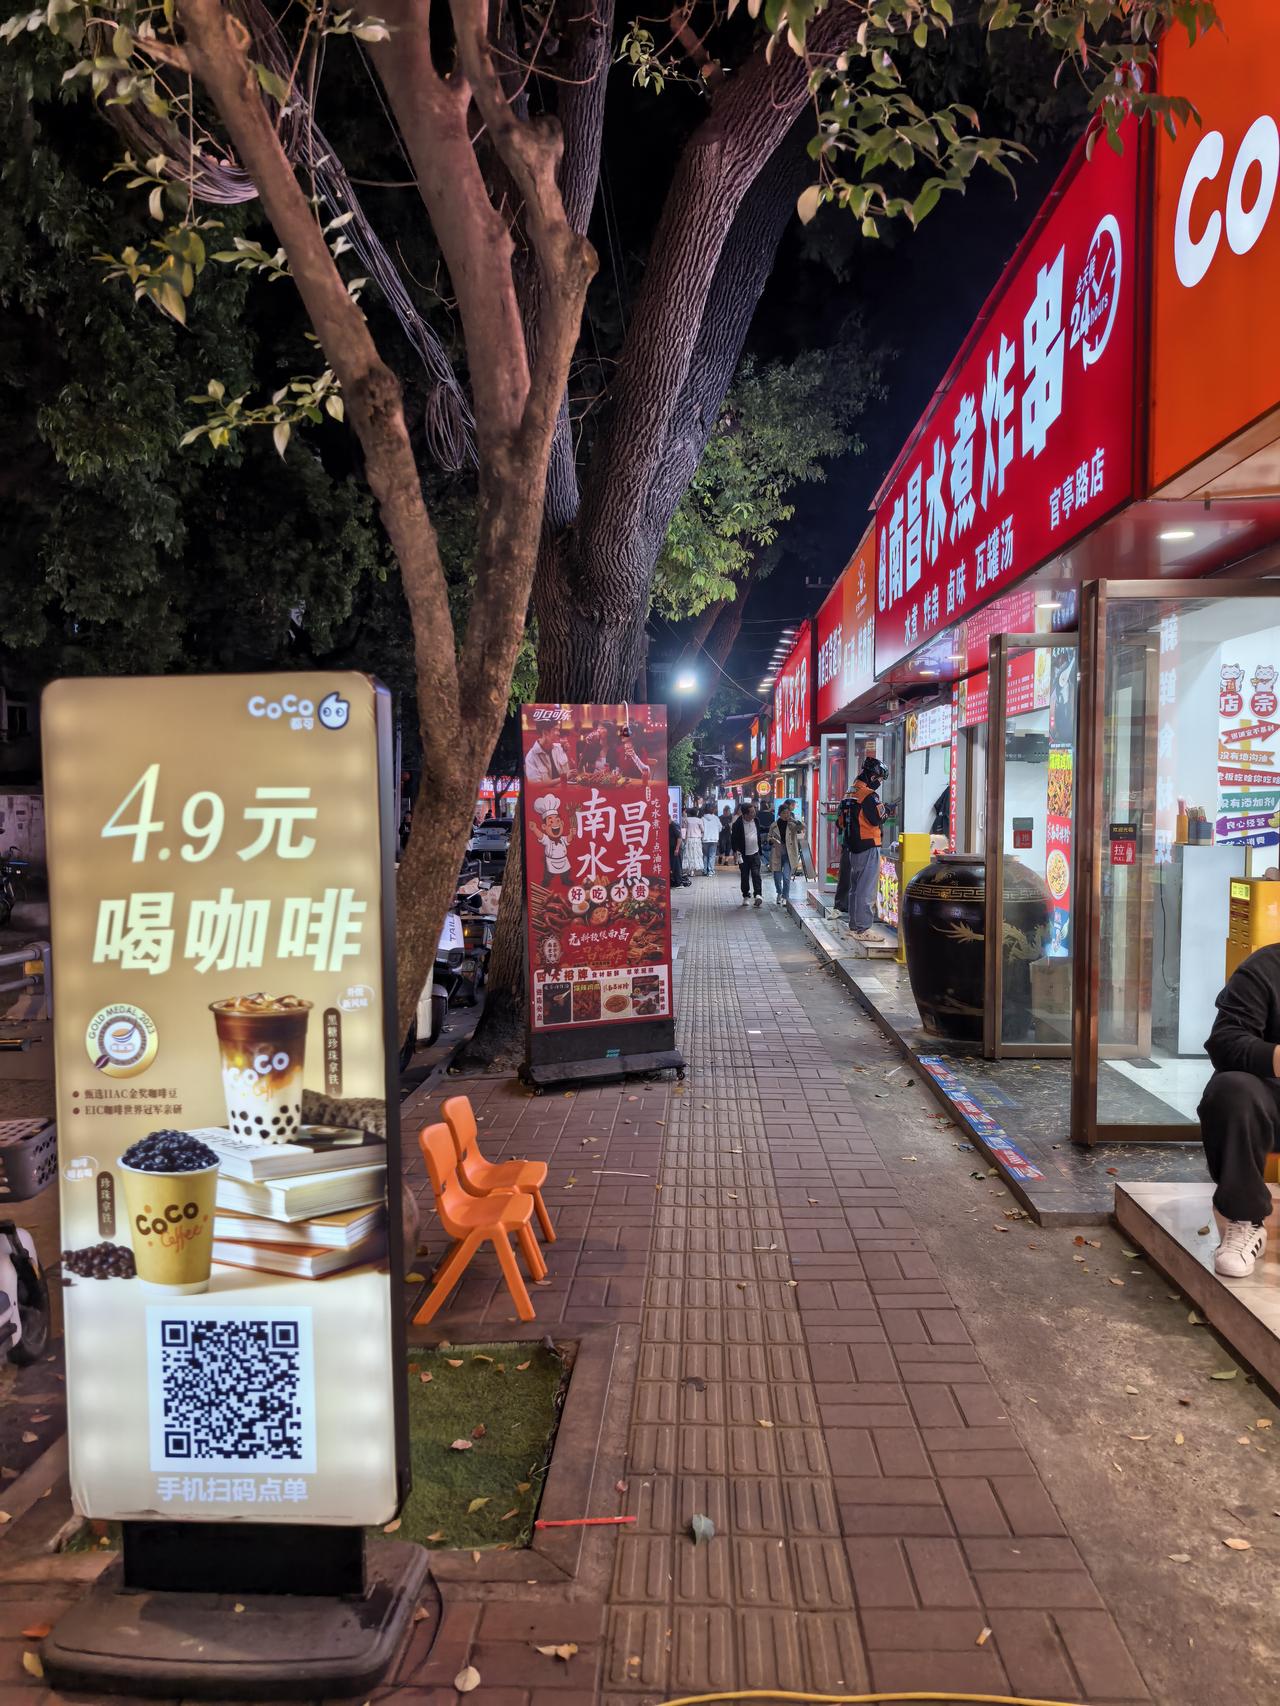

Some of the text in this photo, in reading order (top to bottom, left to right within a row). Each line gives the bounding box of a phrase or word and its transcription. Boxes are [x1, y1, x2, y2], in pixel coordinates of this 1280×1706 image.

[1069, 287, 1109, 351] 24 hours
[887, 243, 1066, 612] 南昌水煮炸串
[1049, 446, 1106, 532] 官亭路店
[904, 602, 918, 647] 水煮
[923, 583, 939, 634] 炸串
[946, 560, 966, 616] 卤味
[975, 513, 1014, 593] 瓦罐汤
[533, 708, 574, 722] 可口可乐
[1219, 751, 1268, 763] 没有地沟油
[575, 787, 652, 848] 南昌
[1226, 817, 1266, 830] 良心经营
[575, 840, 651, 888] 水煮
[1114, 844, 1125, 856] 拉
[569, 884, 649, 903] 好吃不贵
[92, 888, 367, 976] 喝咖啡
[88, 1012, 106, 1040] GOLD
[106, 1005, 137, 1017] MEDAL
[327, 1014, 340, 1085] 黑糖珍珠拿铁
[156, 1476, 308, 1503] 手机扫码点单
